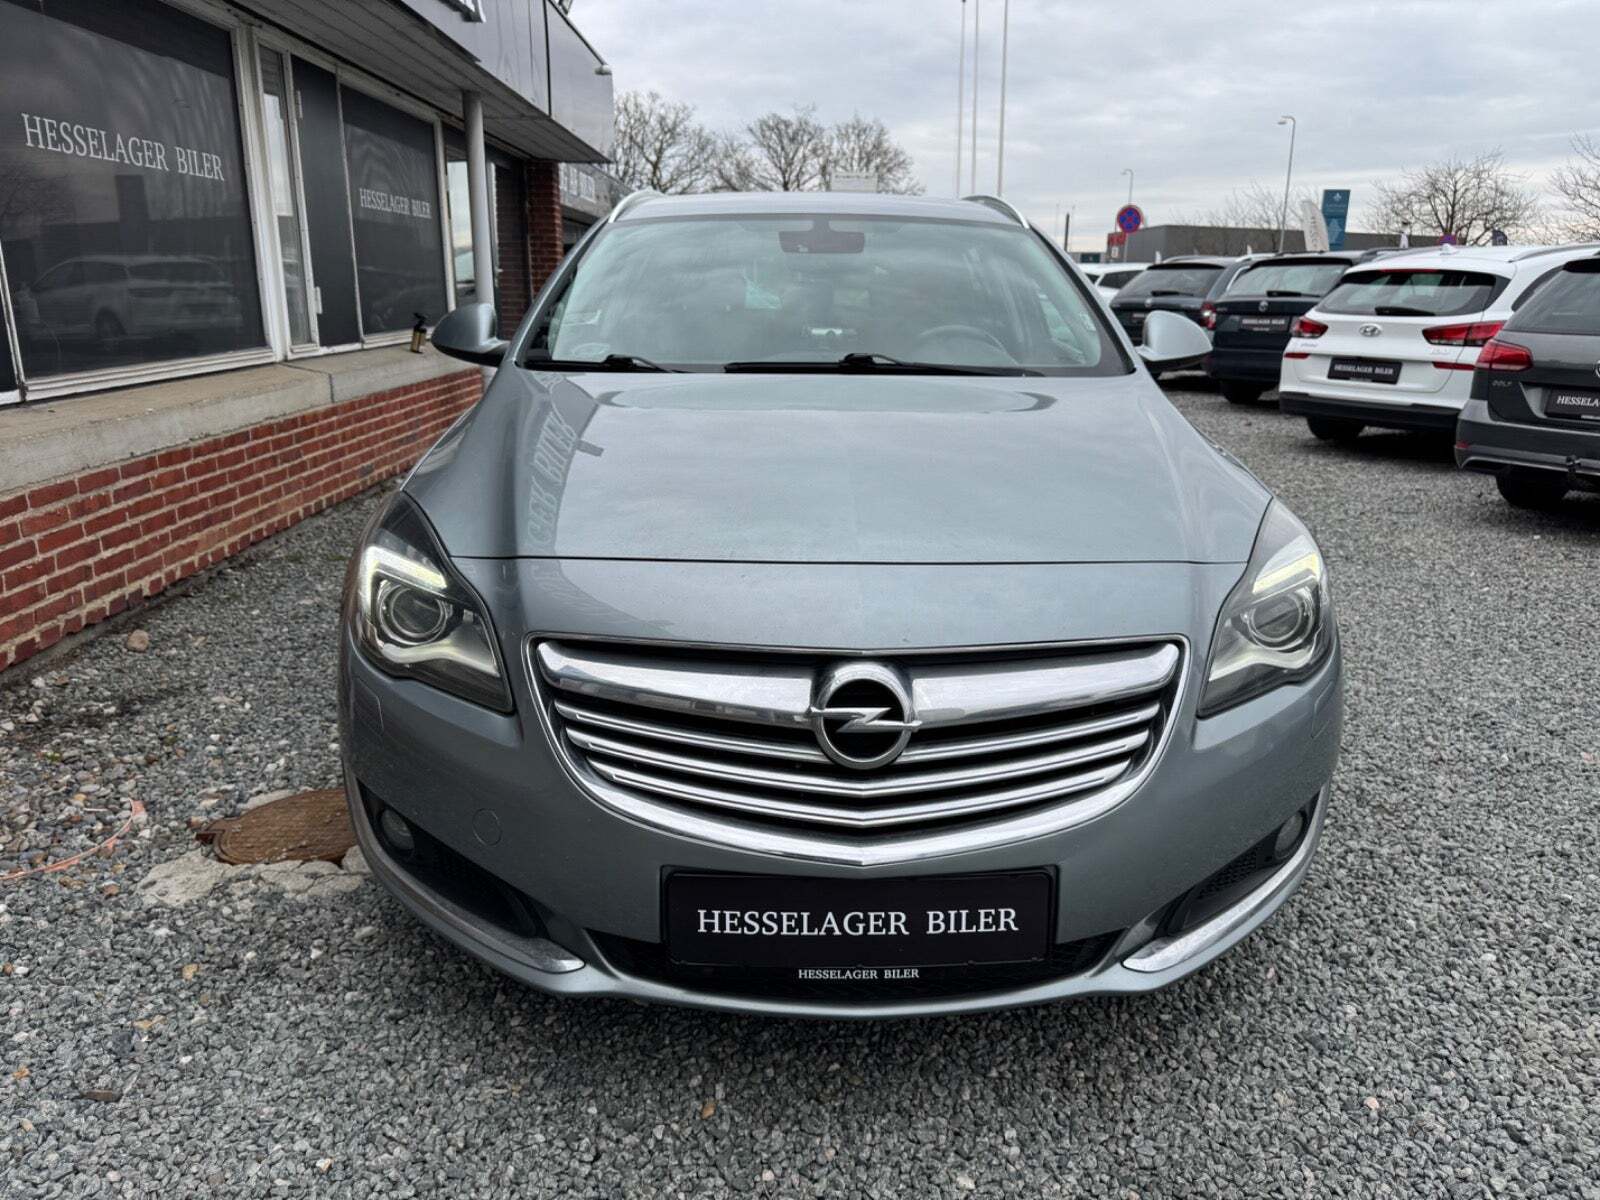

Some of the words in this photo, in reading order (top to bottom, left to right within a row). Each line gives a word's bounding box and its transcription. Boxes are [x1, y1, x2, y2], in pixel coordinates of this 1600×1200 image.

[21, 112, 169, 171] HESSELAGER
[174, 146, 225, 181] BILER
[359, 187, 410, 215] HESSELAGER
[411, 198, 432, 219] BILER
[697, 909, 910, 936] HESSELAGER
[926, 908, 1019, 935] BILER
[798, 968, 878, 980] HESSELAGER
[884, 968, 920, 980] BILER
